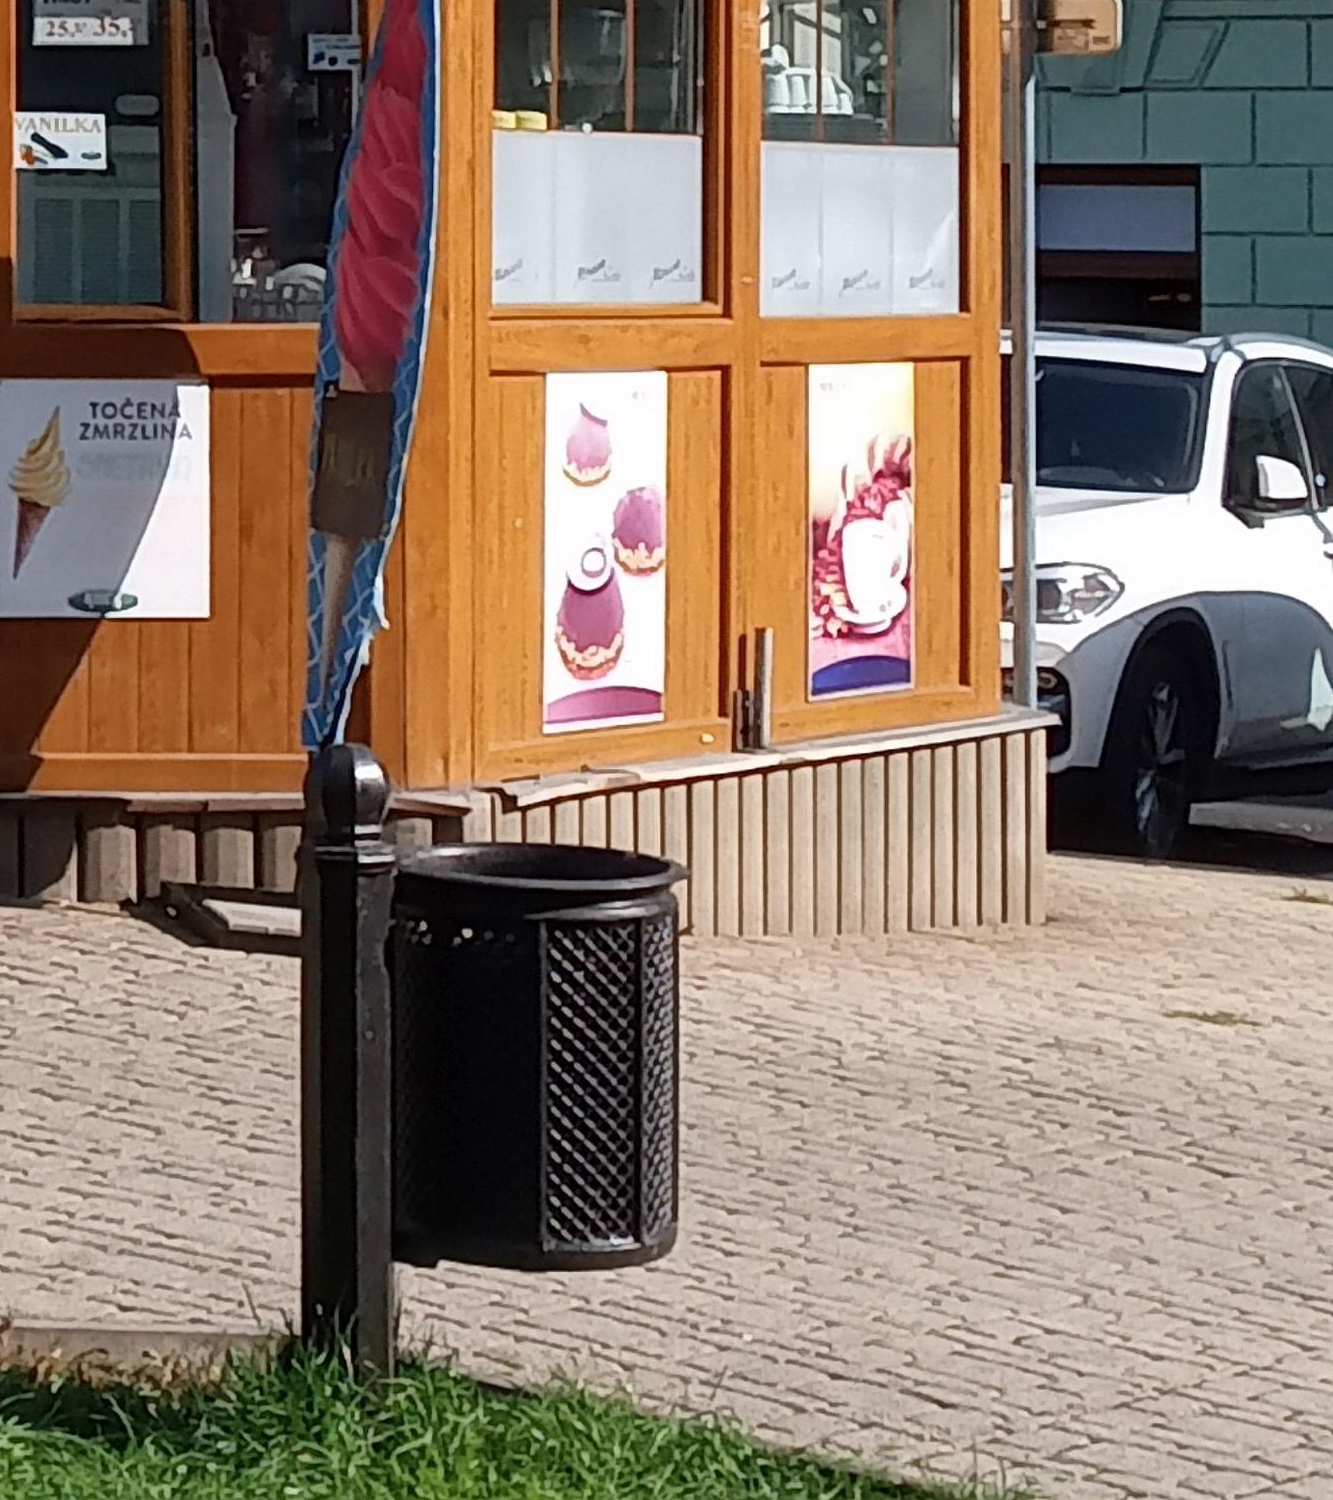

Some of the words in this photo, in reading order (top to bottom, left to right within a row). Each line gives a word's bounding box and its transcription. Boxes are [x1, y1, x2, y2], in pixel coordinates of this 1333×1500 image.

[14, 117, 102, 133] VANILKA
[89, 396, 181, 420] TOČENÁ
[79, 422, 193, 441] ZMRZLINA
